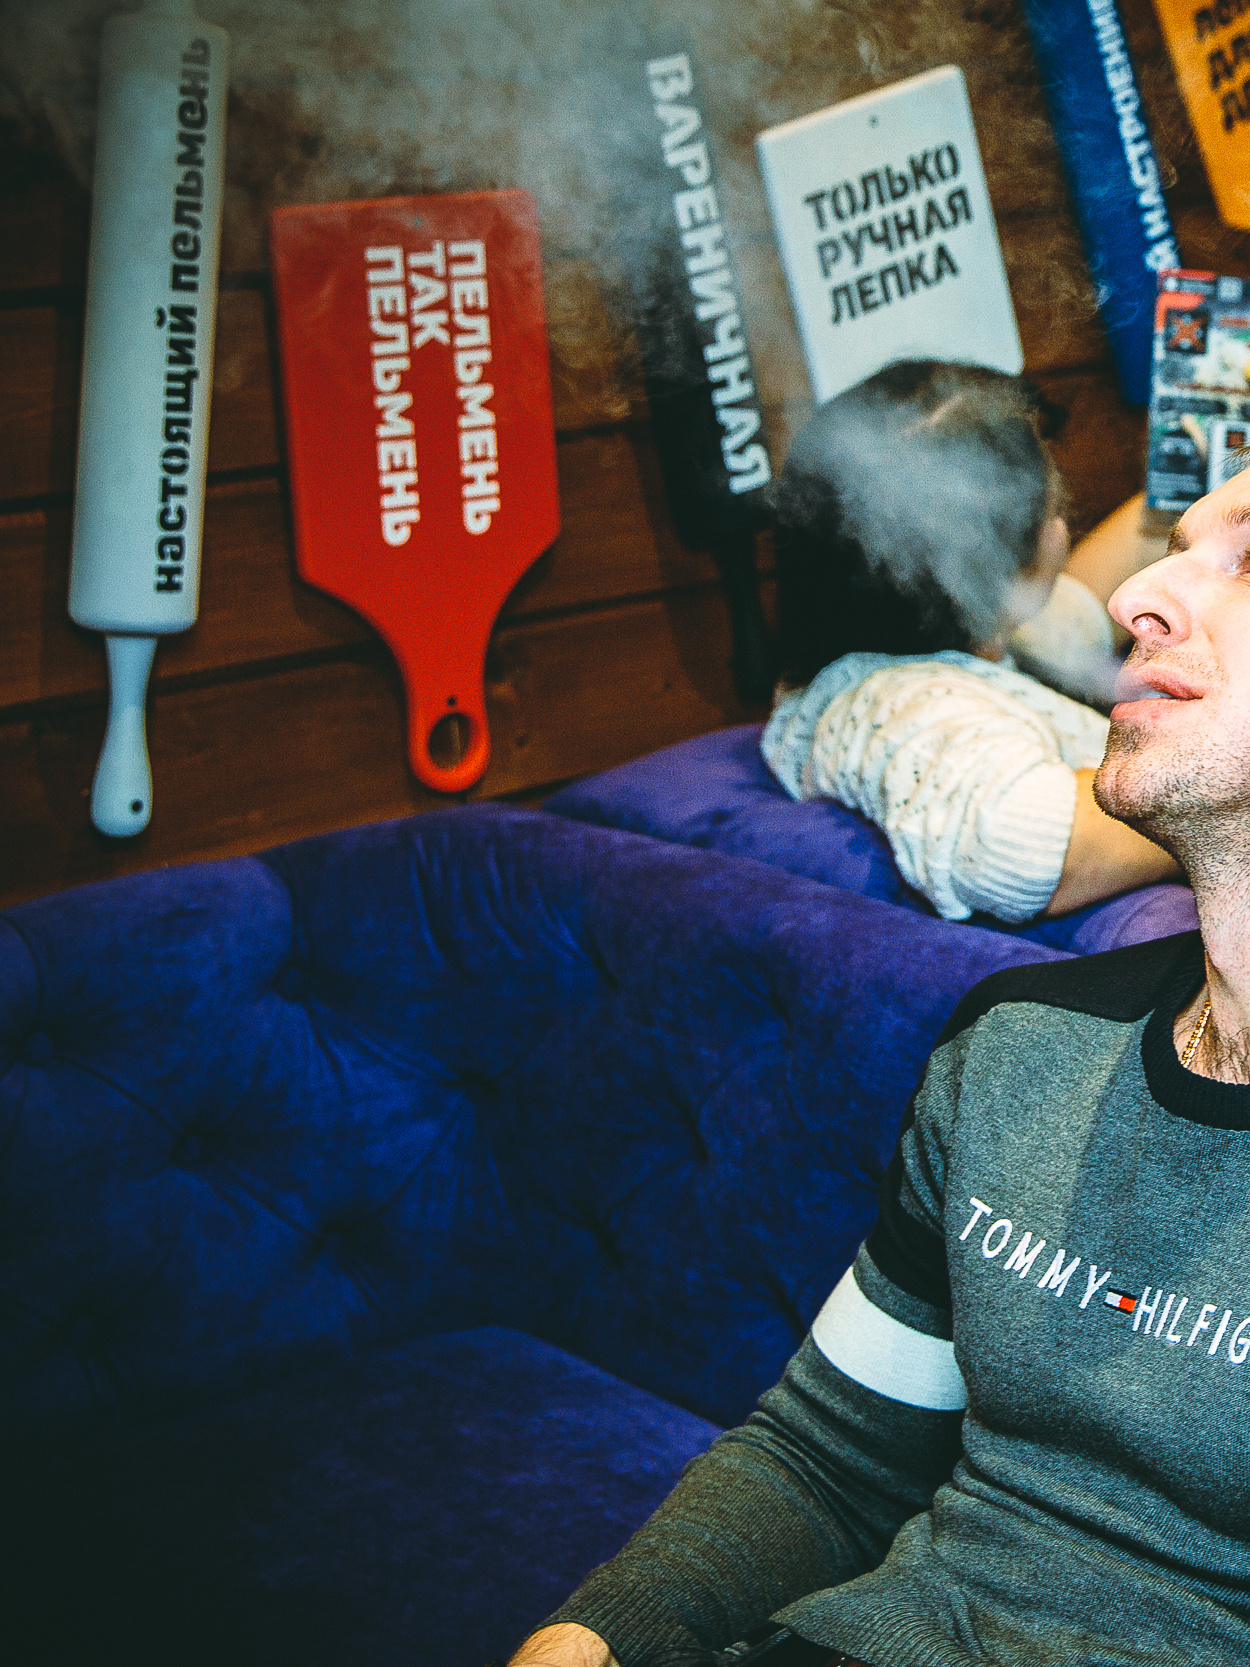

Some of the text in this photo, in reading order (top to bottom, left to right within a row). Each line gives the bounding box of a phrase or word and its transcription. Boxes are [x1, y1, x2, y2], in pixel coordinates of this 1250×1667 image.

[803, 140, 962, 232] ТОЛЬКО
[813, 186, 975, 279] РУЧНАЯ
[154, 38, 211, 595] настоящий пельмень
[409, 242, 448, 348] ТАК
[646, 52, 771, 495] ВАРЕНИЧНАЯ
[826, 243, 961, 326] ЛЕПКА
[366, 247, 421, 547] ПЕЛЬМЕНЬ
[449, 240, 500, 536] ПЕЛЬМЕНЬ
[959, 1197, 1111, 1309] TOMMY
